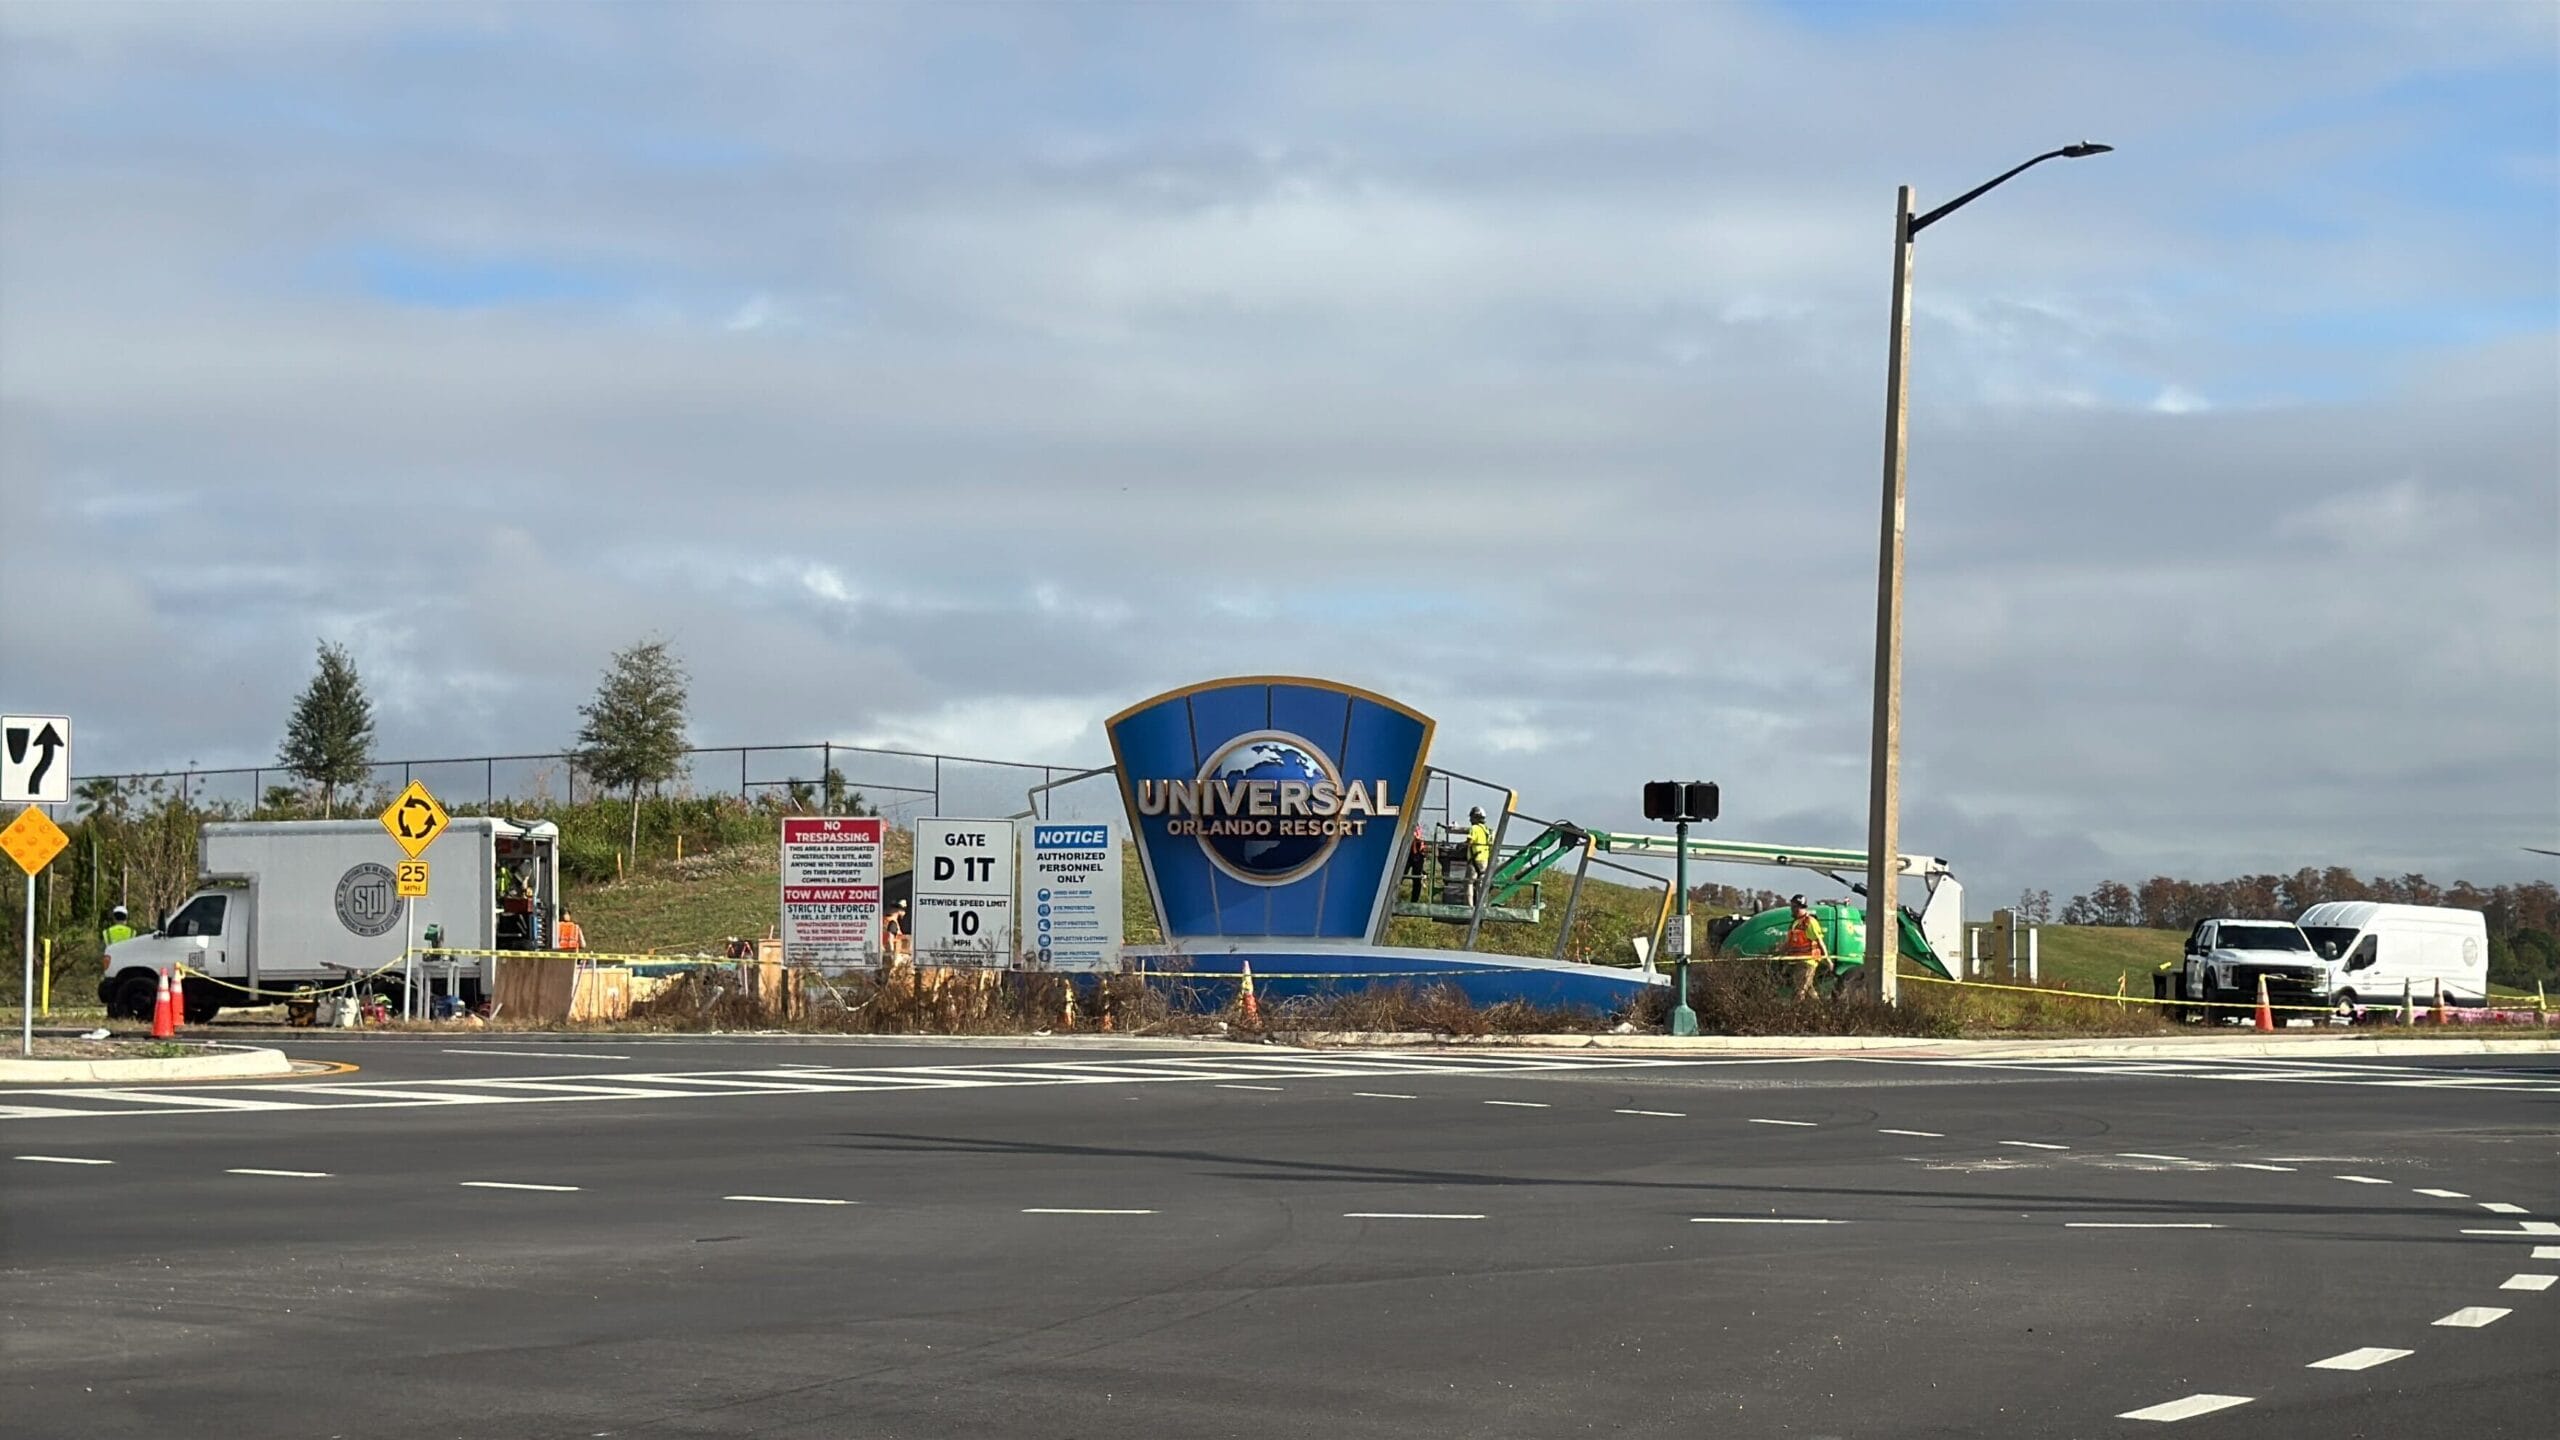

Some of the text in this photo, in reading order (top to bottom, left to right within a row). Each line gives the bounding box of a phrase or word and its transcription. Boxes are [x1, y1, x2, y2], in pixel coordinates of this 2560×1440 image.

[1138, 779, 1400, 816] UNIVERSAL
[824, 821, 841, 831] NO
[1168, 819, 1367, 836] ORLANDO RESORT
[795, 832, 870, 842] TRESPASSING
[945, 833, 986, 846] GATE
[1038, 831, 1104, 844] NOTICE
[401, 866, 425, 882] 25
[934, 856, 995, 881] D 1T
[1040, 864, 1103, 872] PERSONNEL
[1057, 875, 1085, 883] ONLY
[354, 880, 386, 920] spi
[786, 890, 878, 899] TOW AWAY ZONE
[788, 904, 875, 913] STRICTLY ENFORCED
[949, 910, 979, 935] 10
